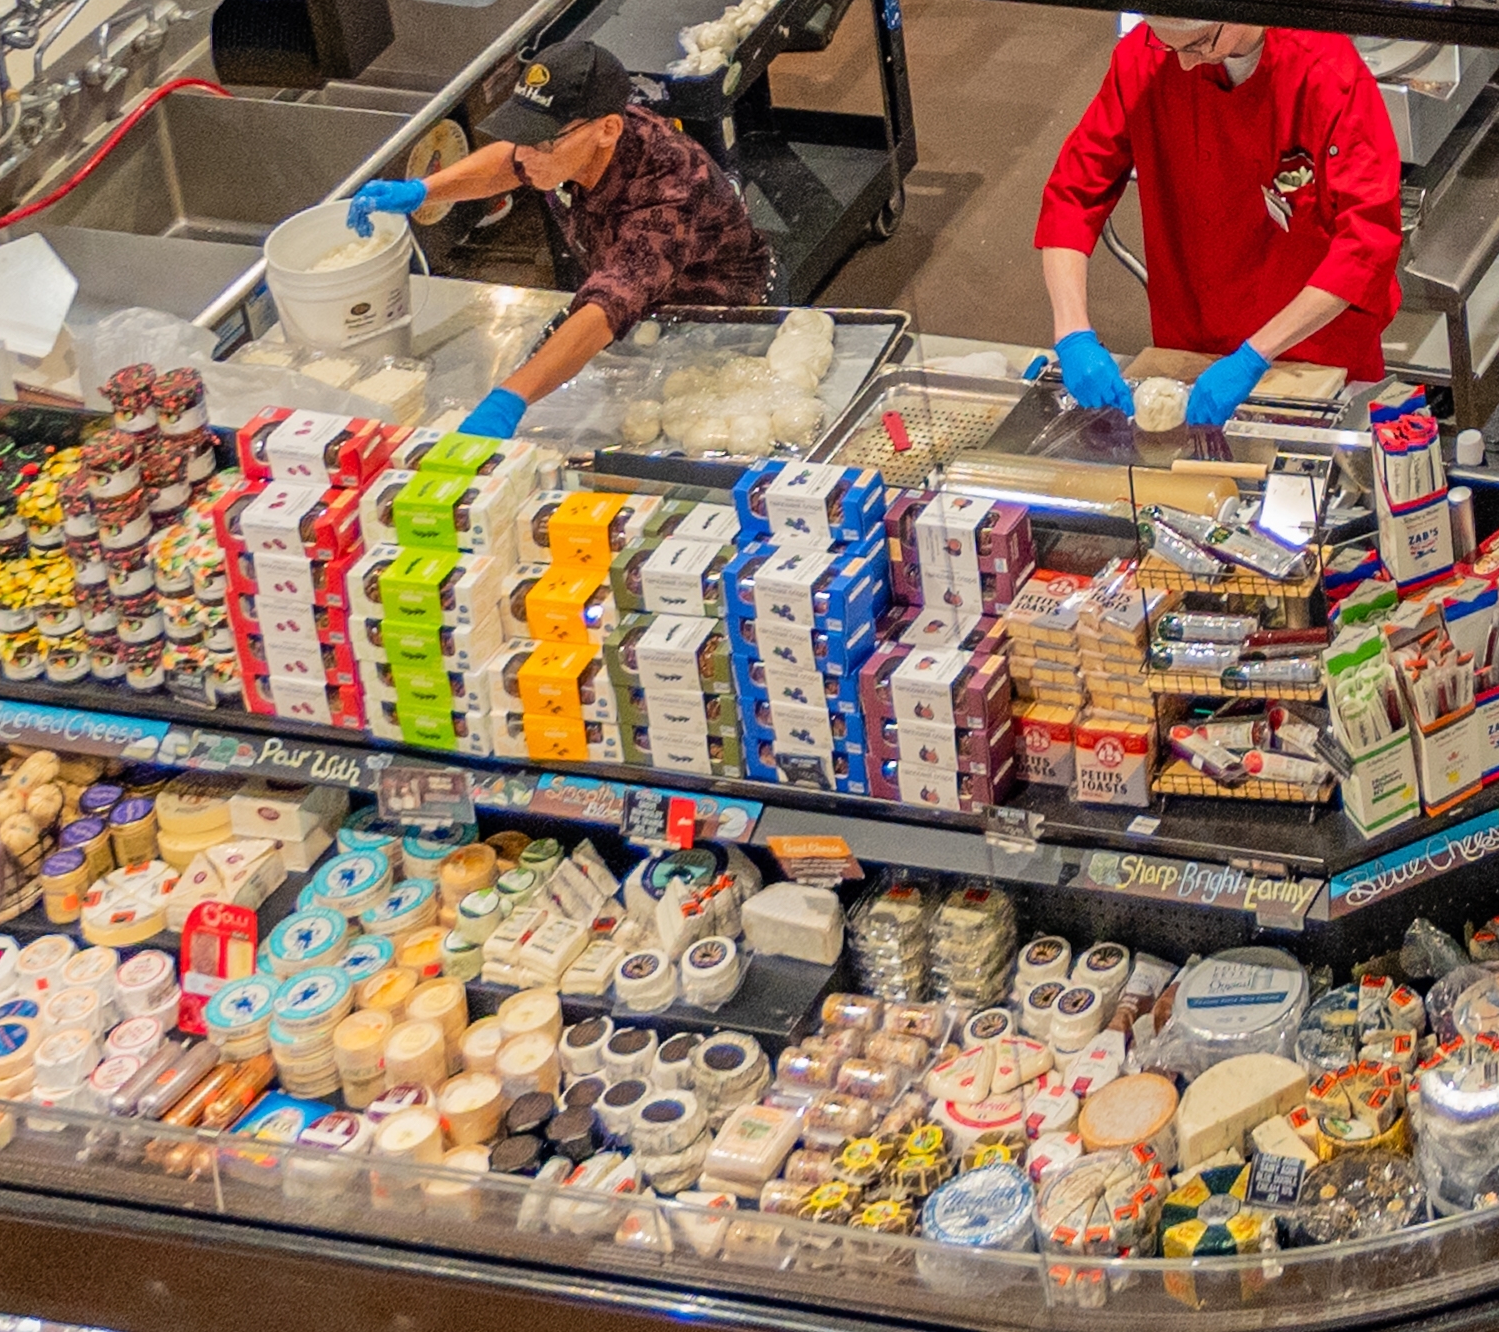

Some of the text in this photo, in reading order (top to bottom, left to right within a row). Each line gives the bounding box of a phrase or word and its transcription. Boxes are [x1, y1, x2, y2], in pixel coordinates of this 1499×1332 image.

[1409, 526, 1438, 545] ZAB'S
[1021, 593, 1061, 607] PETITS
[1014, 603, 1061, 617] TOASTS
[68, 712, 143, 744] Cheese
[257, 738, 361, 787] Pair With
[1081, 769, 1123, 782] PETITS
[1080, 780, 1128, 795] TOASTS
[1115, 855, 1178, 891] Sharp
[1178, 862, 1242, 903] Bright
[1344, 857, 1427, 904] Blue
